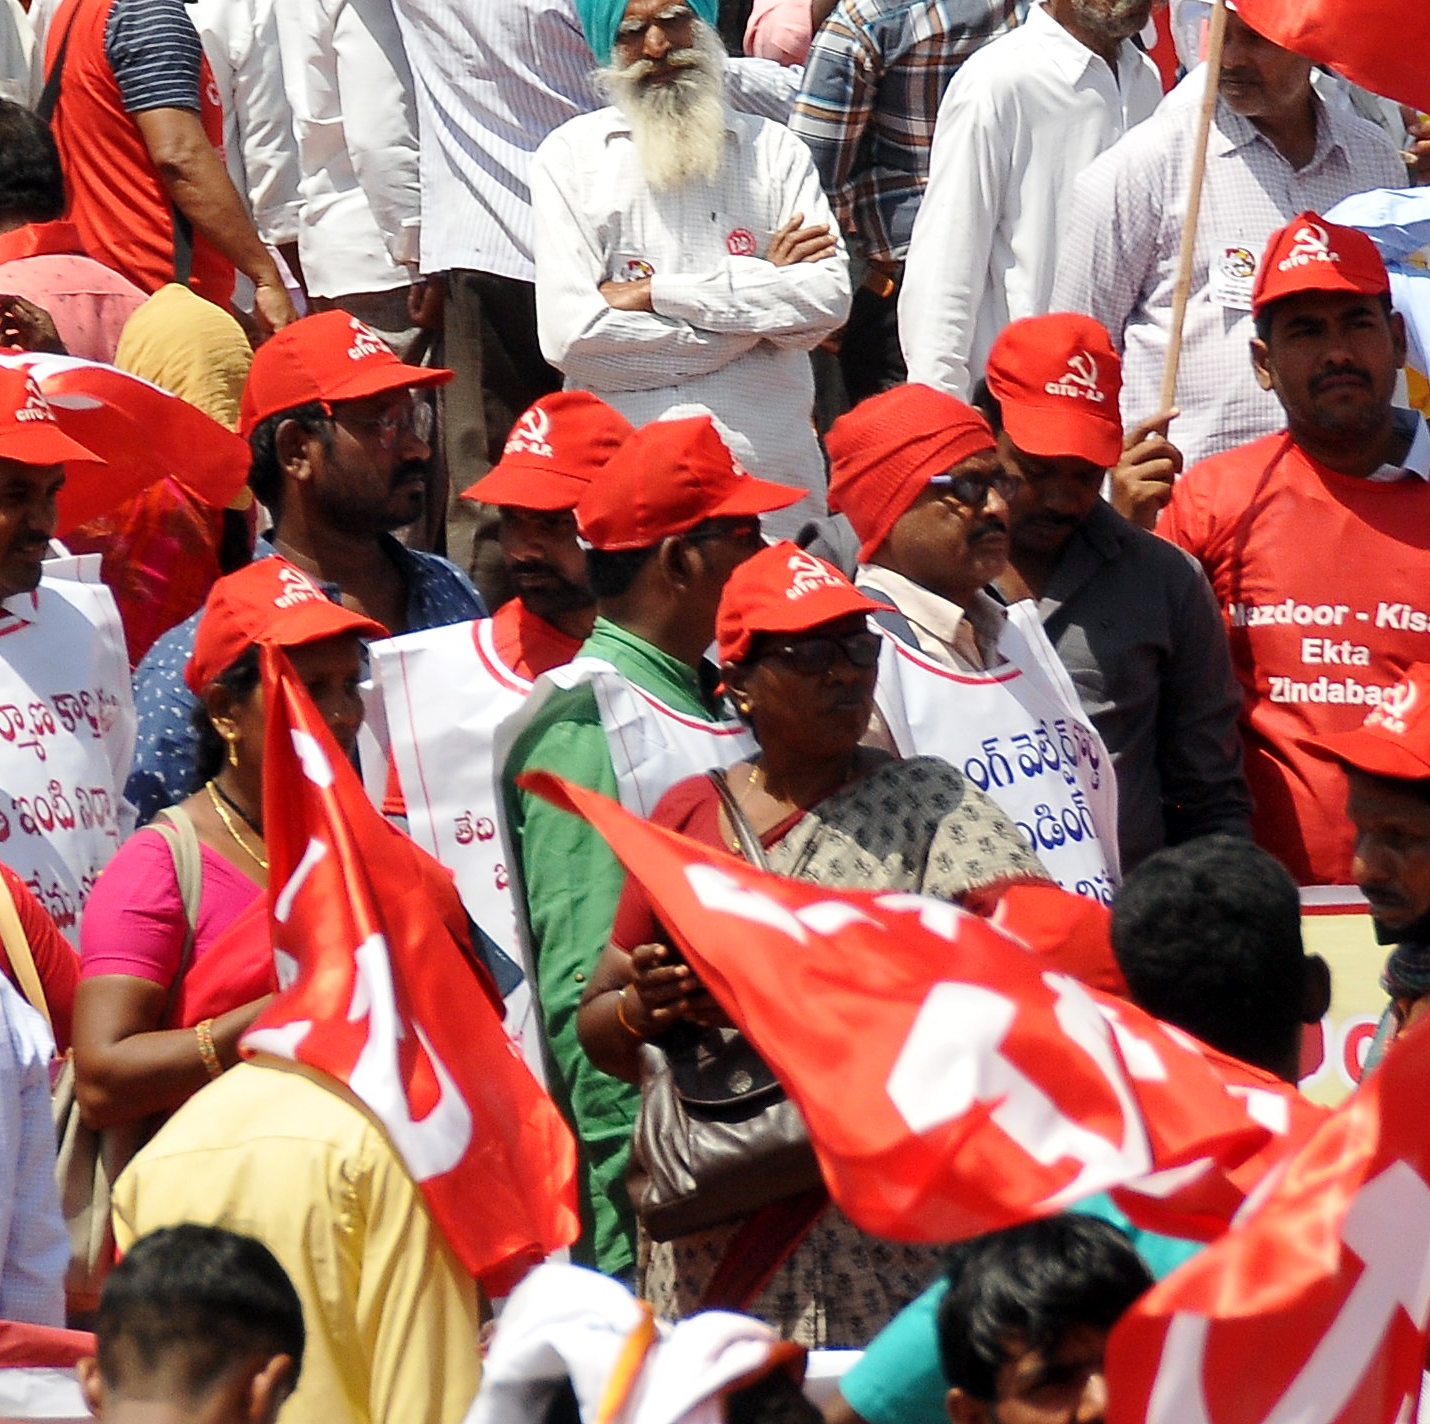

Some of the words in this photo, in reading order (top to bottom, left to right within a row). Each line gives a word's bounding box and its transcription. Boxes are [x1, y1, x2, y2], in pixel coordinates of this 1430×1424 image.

[1229, 599, 1350, 628] Mazdoor
[1301, 637, 1370, 667] Ekta
[1268, 676, 1385, 707] Zindaba
